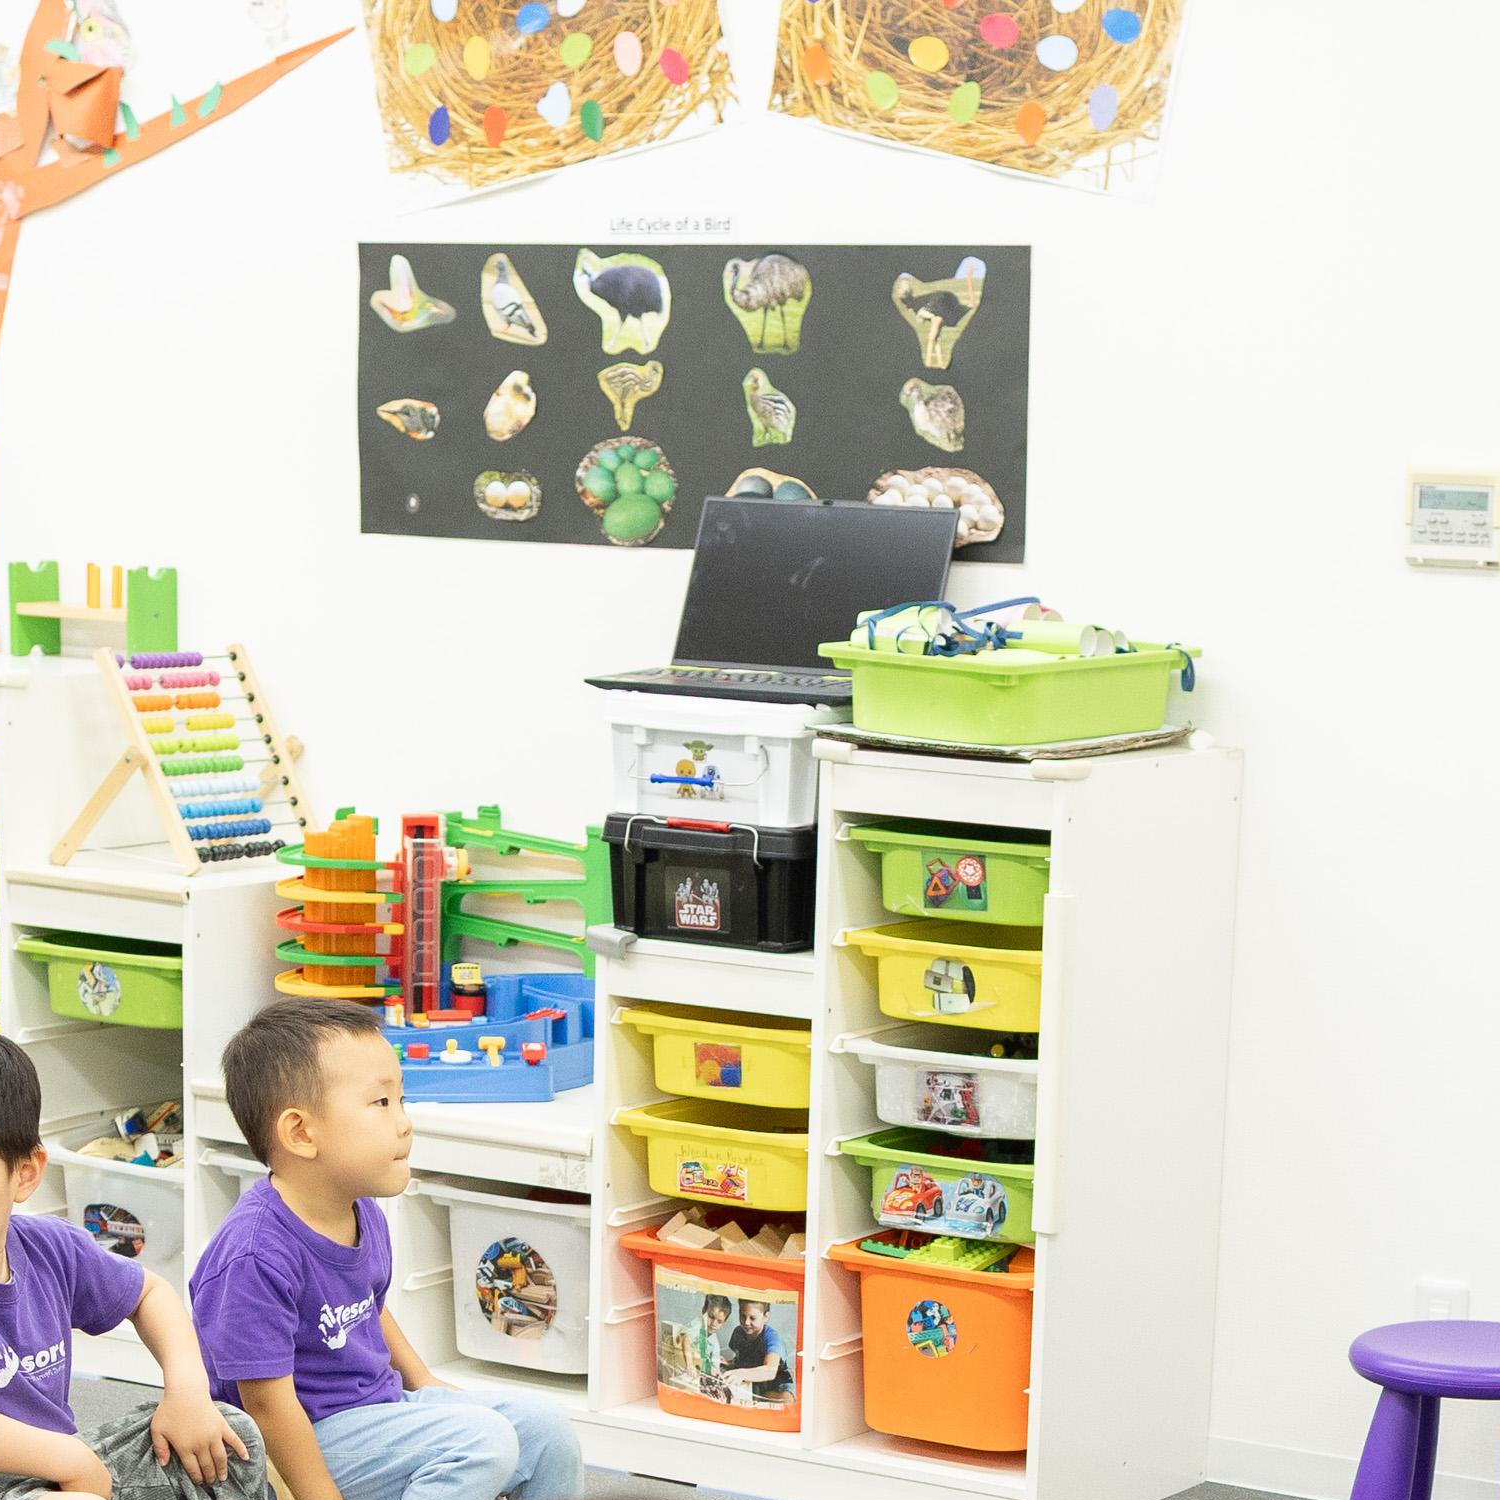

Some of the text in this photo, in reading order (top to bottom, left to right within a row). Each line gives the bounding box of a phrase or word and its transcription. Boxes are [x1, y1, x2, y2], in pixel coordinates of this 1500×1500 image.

[610, 216, 731, 234] Life Cycle of a Bird
[678, 903, 717, 916] STAR
[678, 913, 718, 927] WARS
